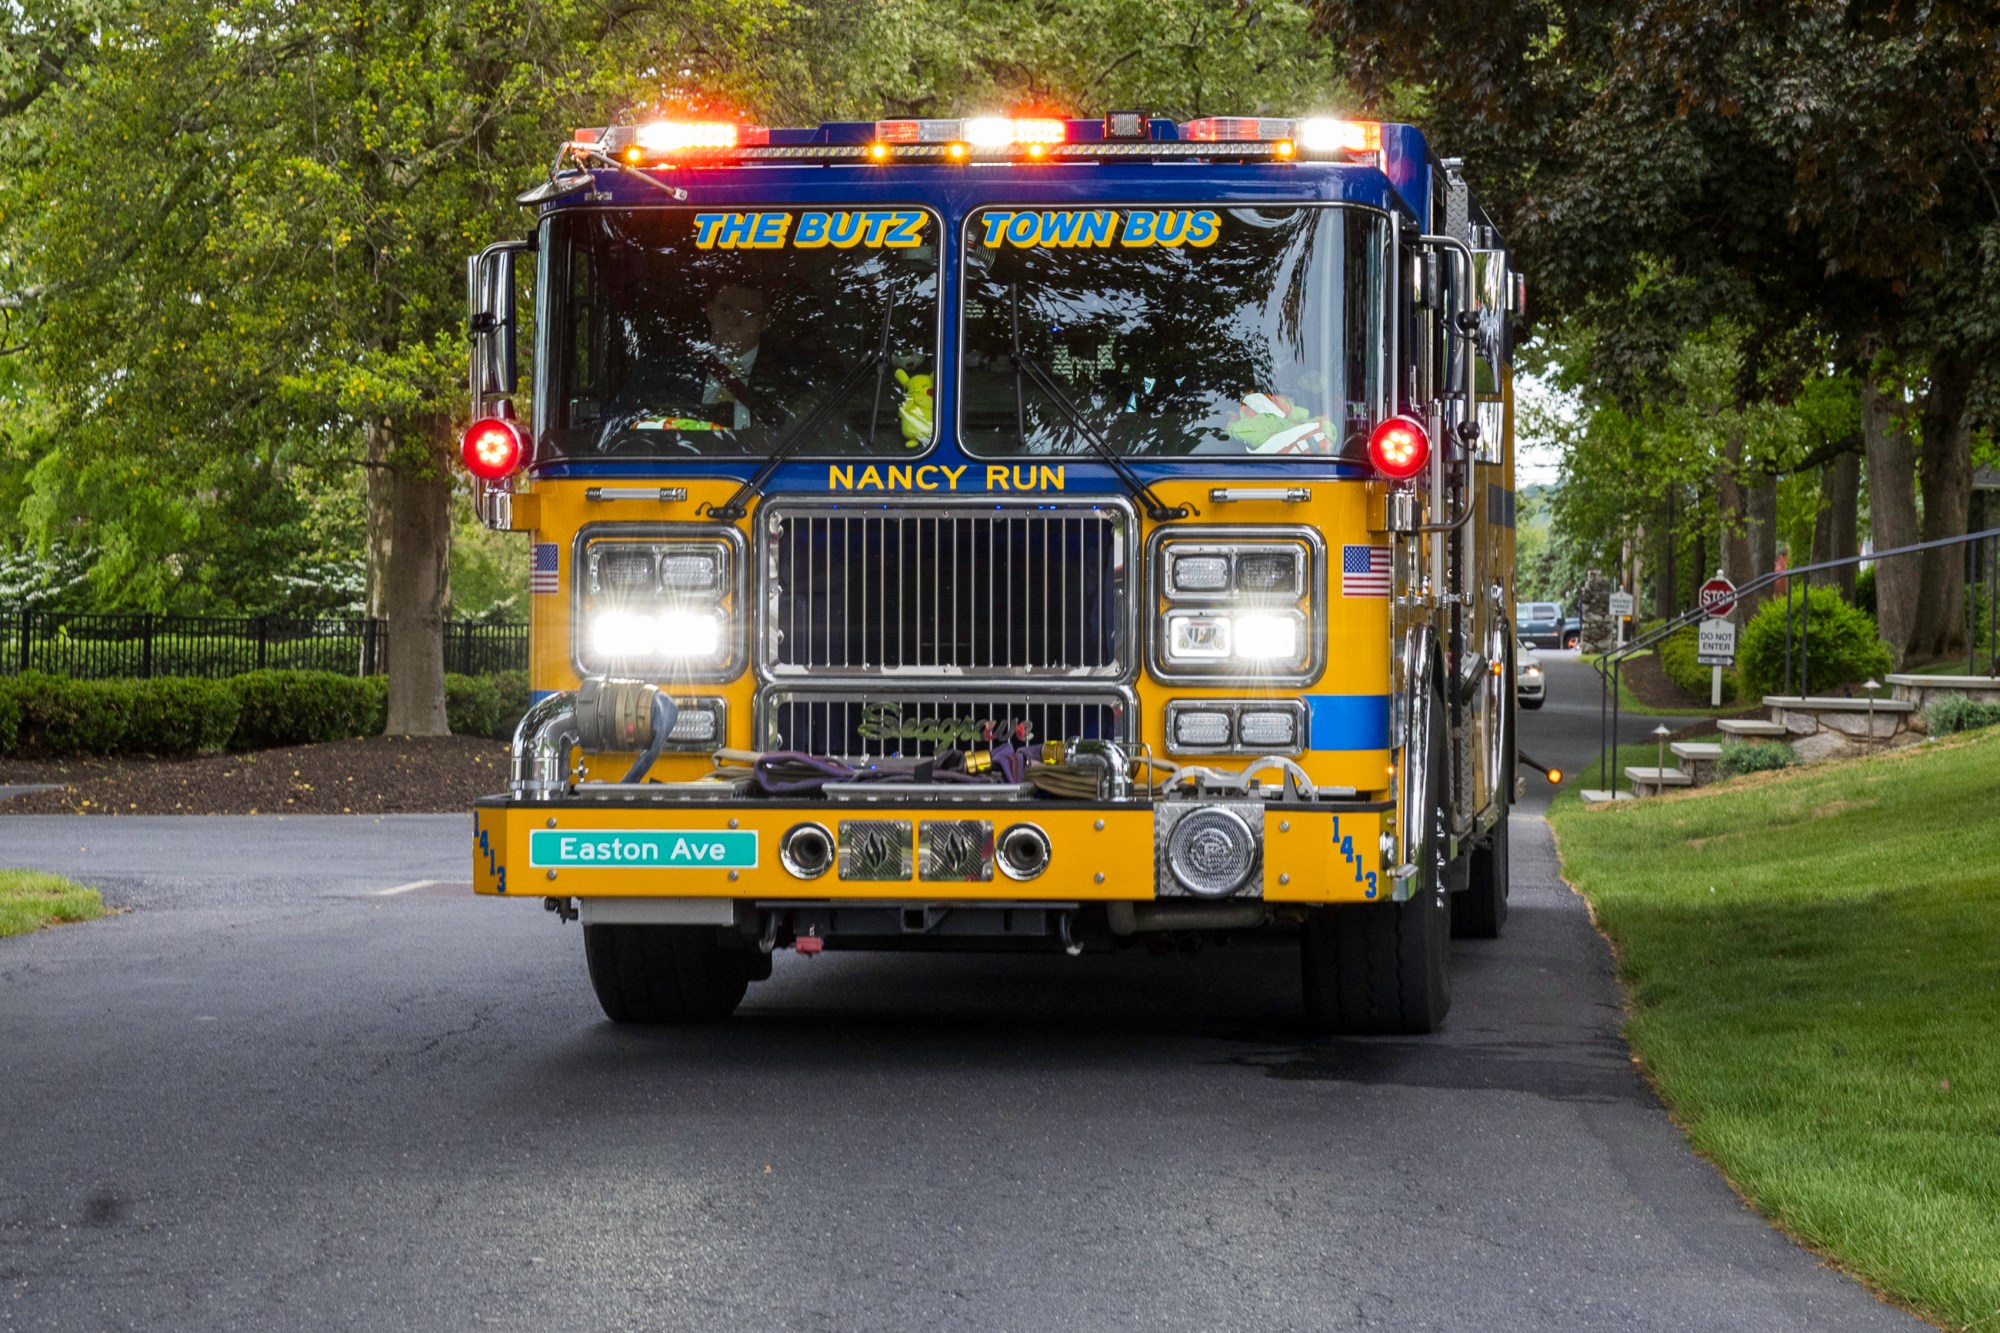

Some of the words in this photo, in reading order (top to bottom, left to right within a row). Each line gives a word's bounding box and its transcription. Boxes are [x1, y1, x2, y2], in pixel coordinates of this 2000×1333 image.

[694, 211, 791, 249] THE
[793, 211, 929, 249] BUTZ
[982, 210, 1119, 248] TOWN
[1121, 210, 1222, 248] BUS
[829, 465, 967, 490] NANCY
[986, 465, 1065, 490] RUN
[1700, 632, 1714, 640] DO
[1715, 633, 1732, 641] NOT
[1702, 642, 1731, 650] ENTER
[559, 837, 659, 861] Easton
[670, 837, 727, 861] Ave
